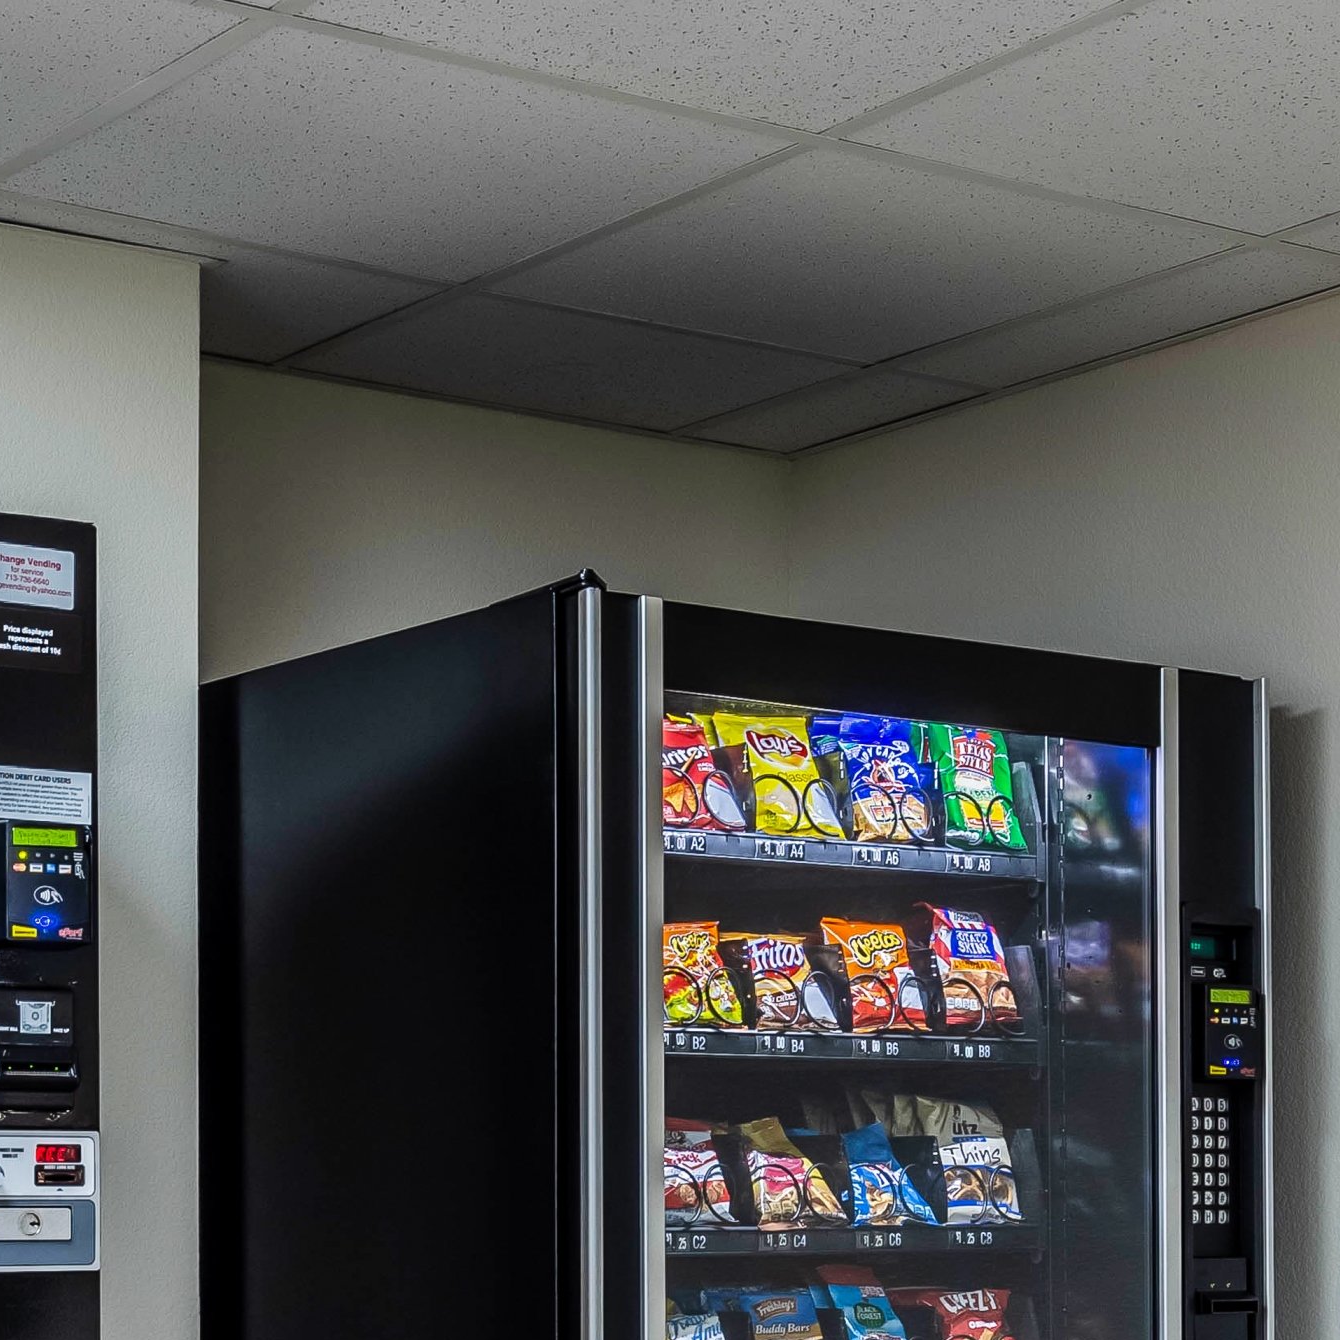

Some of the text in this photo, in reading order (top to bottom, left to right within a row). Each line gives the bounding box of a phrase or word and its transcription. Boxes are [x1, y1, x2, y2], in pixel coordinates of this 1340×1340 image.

[28, 558, 61, 571] Vending
[21, 568, 44, 576] service
[3, 625, 54, 637] Price displayed
[8, 635, 42, 644] represents
[12, 644, 40, 653] discount
[41, 646, 49, 654] of
[754, 732, 803, 756] Lay's
[955, 740, 992, 761] TEXAS
[959, 755, 991, 774] STYLE
[691, 838, 705, 851] A2
[790, 846, 804, 858] A4
[885, 852, 899, 865] A6
[978, 857, 991, 871] A8
[850, 932, 902, 964] Cheetos
[752, 940, 804, 972] Fritos
[692, 1036, 706, 1050] B2
[792, 1039, 804, 1052] B4
[886, 1042, 899, 1056] B6
[979, 1045, 990, 1058] B8
[943, 1144, 1001, 1165] Thins
[693, 1236, 706, 1249] C2
[794, 1235, 806, 1247] C4
[889, 1233, 902, 1246] C6
[980, 1232, 992, 1245] C8
[756, 1300, 795, 1316] Freshley's
[756, 1323, 810, 1335] Buddy Bars
